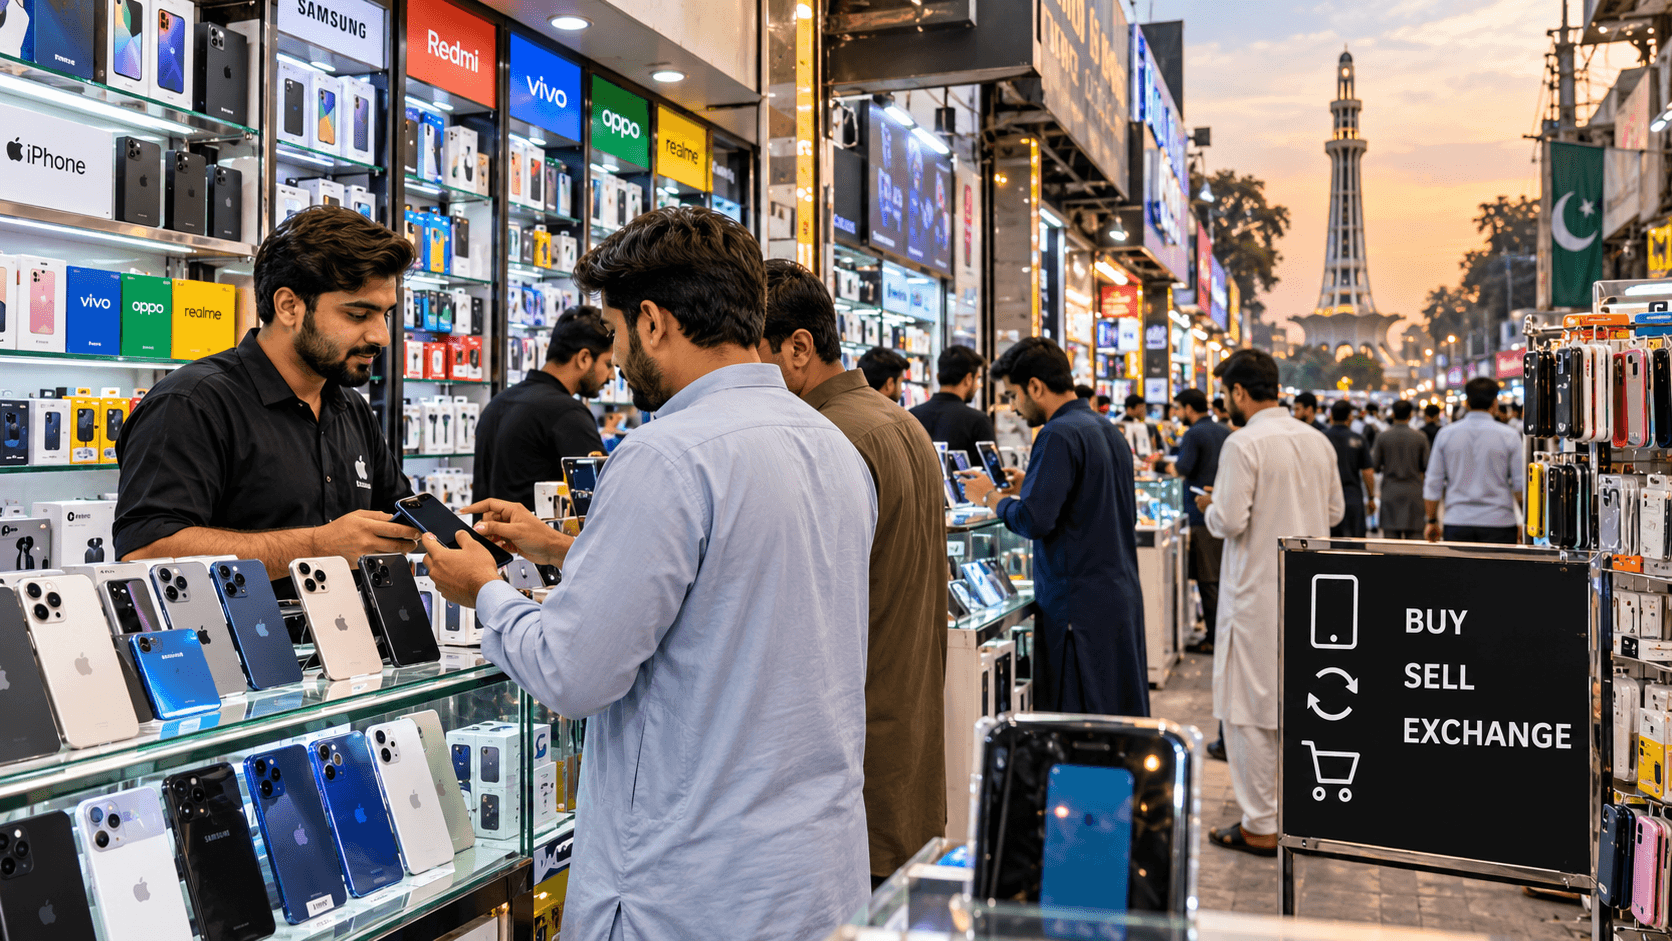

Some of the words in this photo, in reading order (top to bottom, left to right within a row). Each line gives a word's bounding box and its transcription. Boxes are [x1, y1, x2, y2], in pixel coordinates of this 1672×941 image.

[297, 0, 367, 39] SAMSUNG
[427, 28, 479, 73] Redmi
[526, 75, 568, 109] vivo
[602, 109, 640, 139] oppo
[27, 144, 86, 175] iPhone
[666, 139, 699, 165] realme
[80, 293, 111, 310] vivo
[132, 301, 164, 316] oppo
[184, 306, 222, 320] realme
[1405, 607, 1468, 635] BUY
[1404, 662, 1475, 691] SELL
[1403, 717, 1572, 749] EXCHANGE
